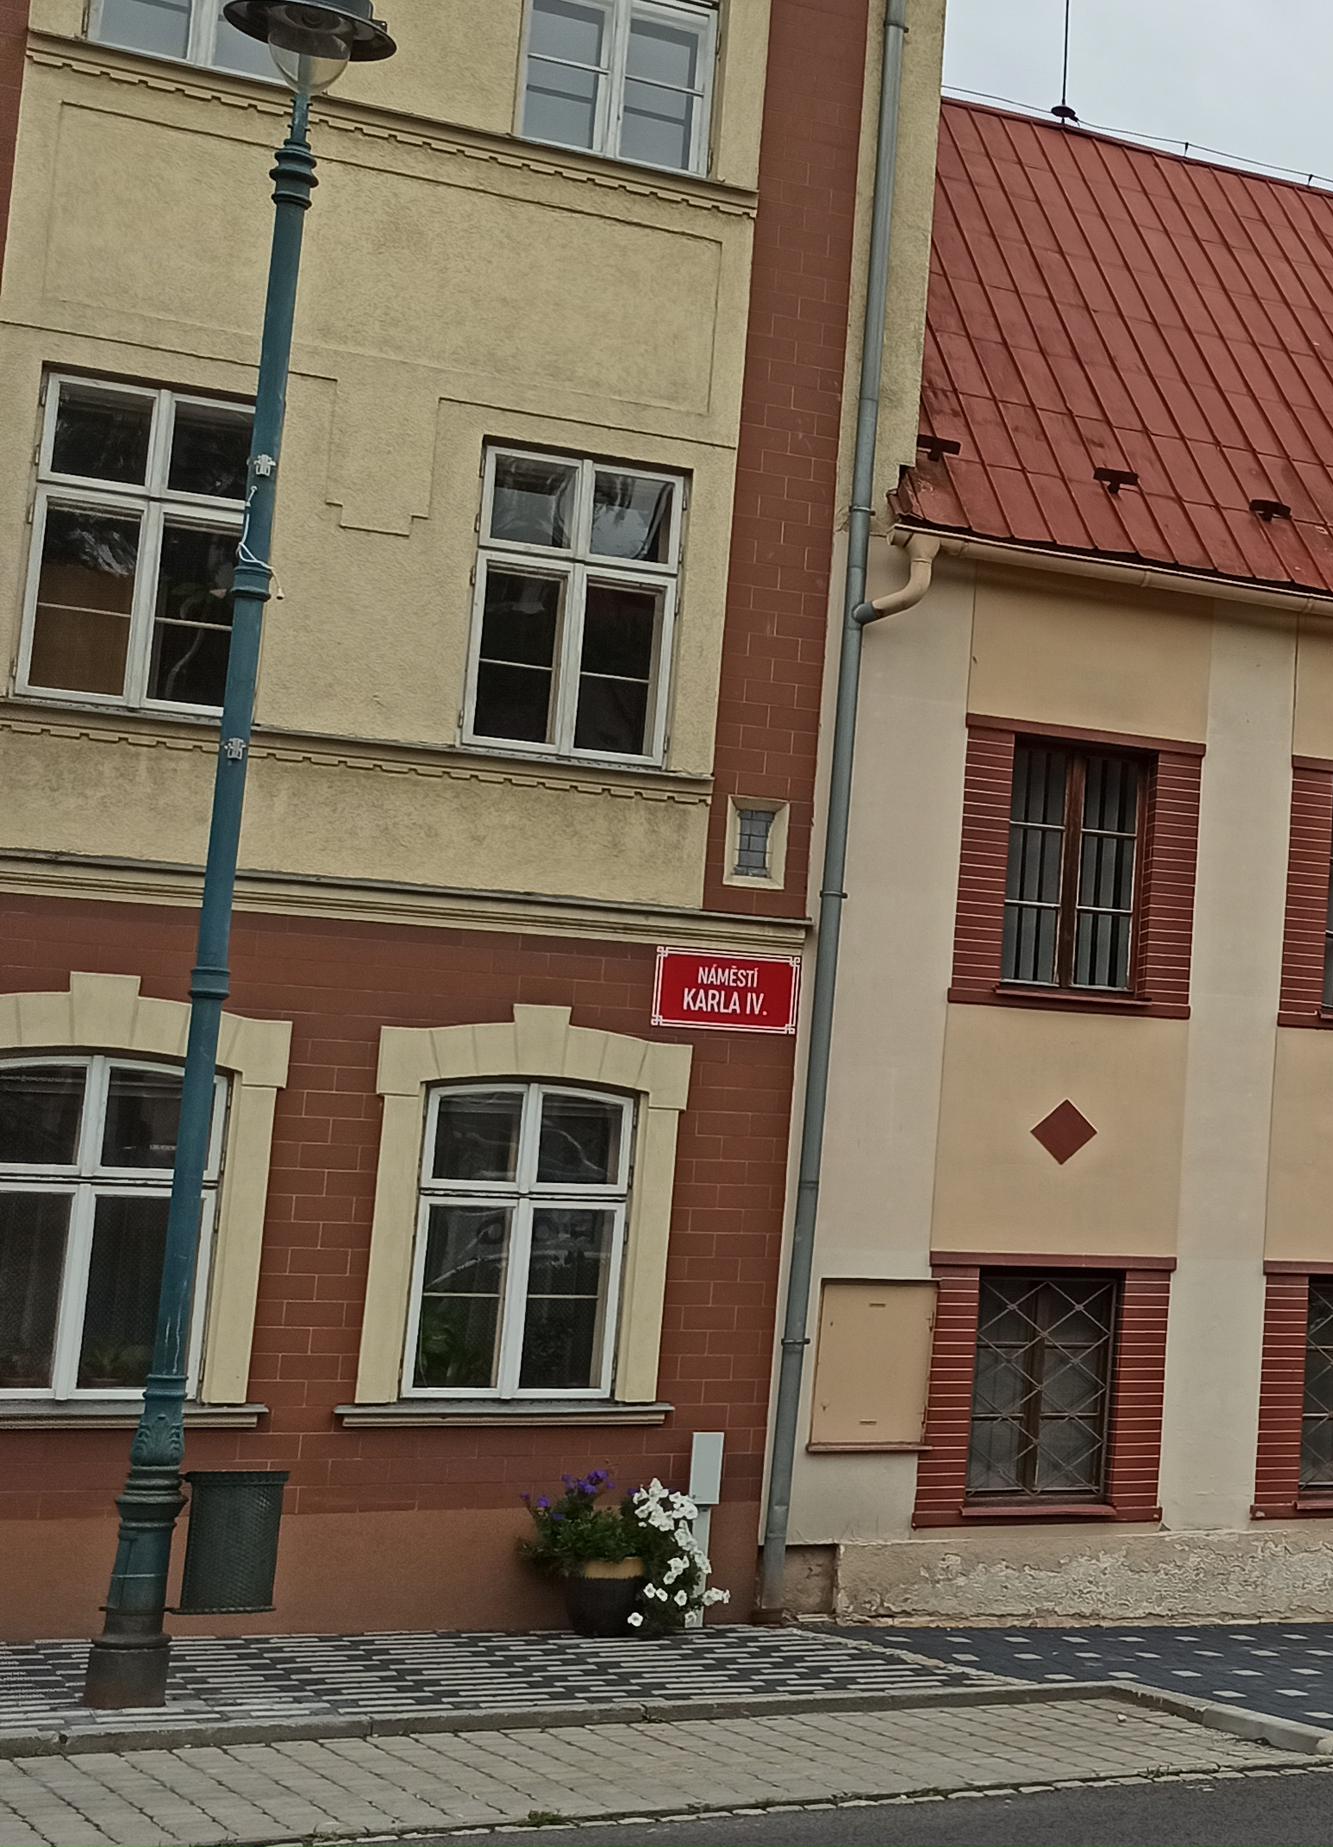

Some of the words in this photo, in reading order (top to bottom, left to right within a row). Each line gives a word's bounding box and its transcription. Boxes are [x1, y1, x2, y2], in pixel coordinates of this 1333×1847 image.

[698, 963, 759, 988] NÁMĚSTÍ
[683, 988, 740, 1014] KARLA
[746, 992, 768, 1016] IV.
